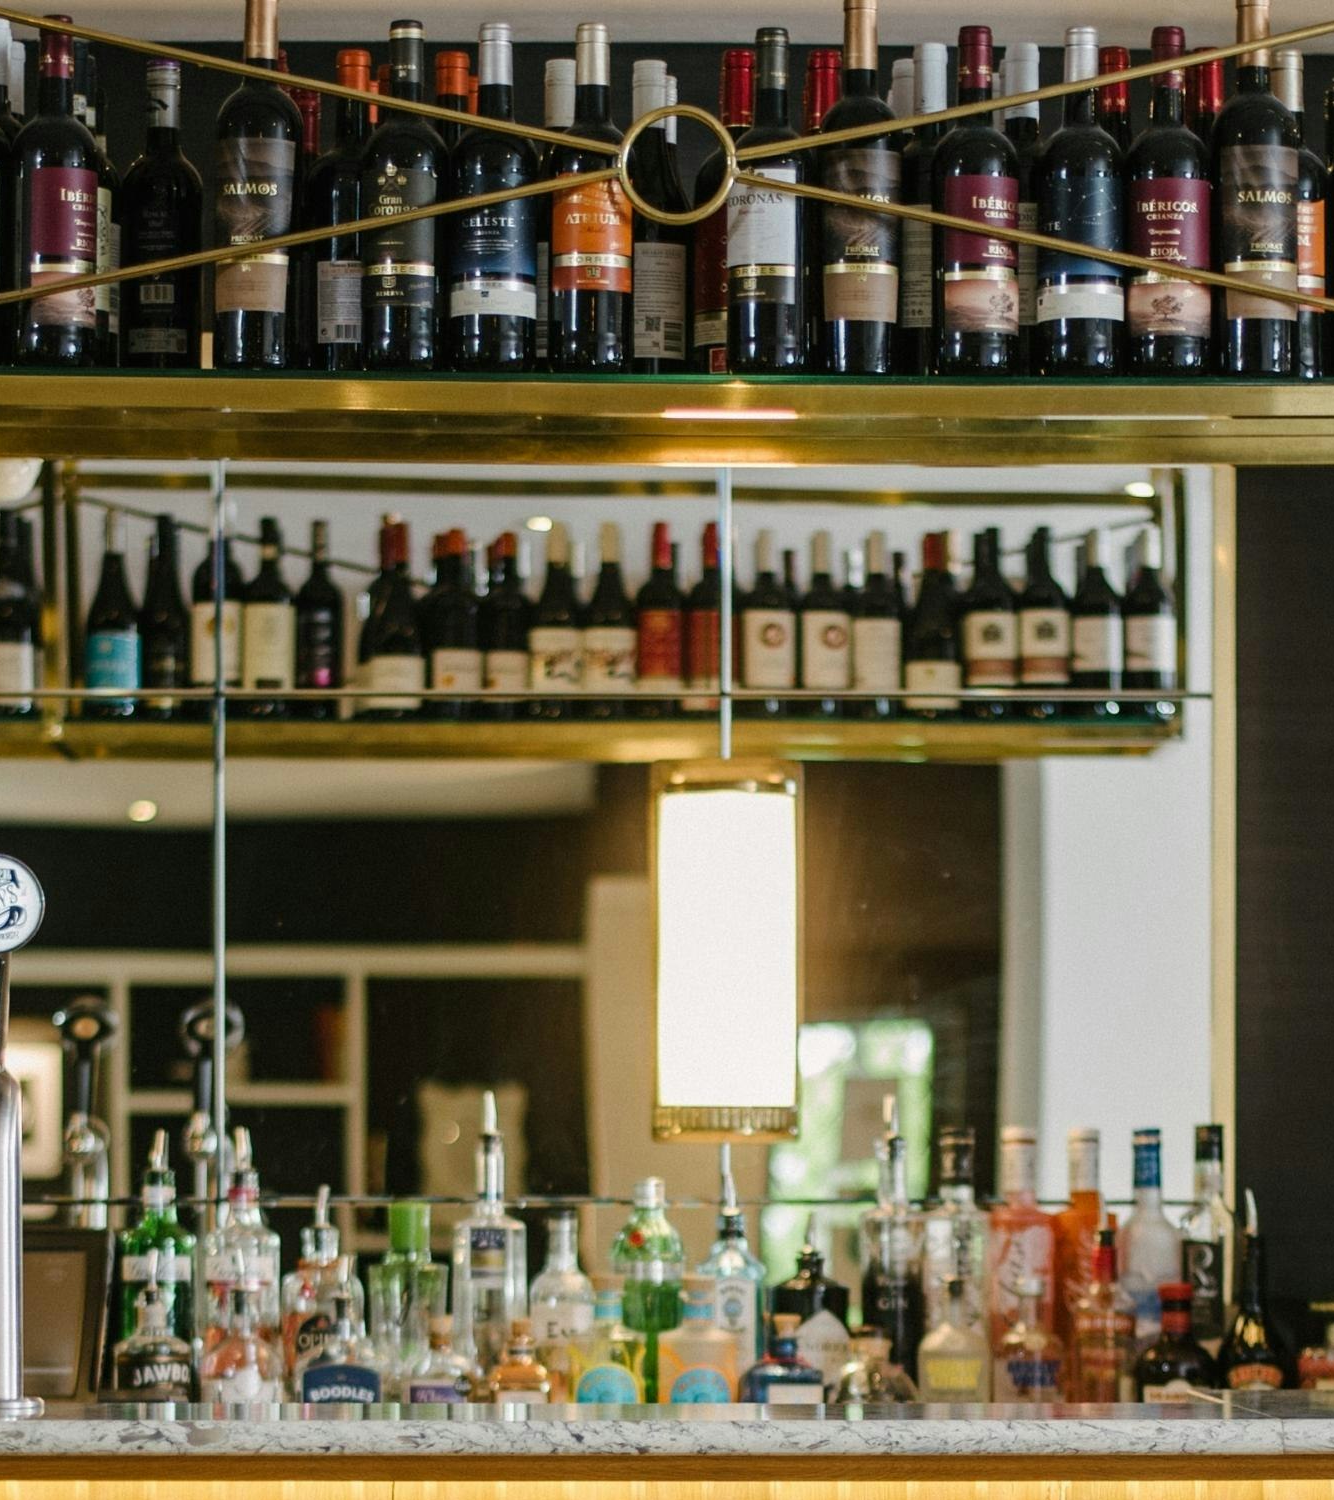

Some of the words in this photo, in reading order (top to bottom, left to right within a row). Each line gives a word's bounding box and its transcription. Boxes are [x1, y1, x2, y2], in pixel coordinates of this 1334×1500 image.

[223, 183, 278, 196] SALMOS
[379, 195, 402, 205] Gran
[1238, 189, 1292, 203] SALMOS
[1137, 200, 1199, 214] IBÉRICOS
[462, 216, 515, 228] CELESTE
[565, 212, 620, 226] ATRIUM
[1147, 213, 1185, 221] CRIANZA
[845, 245, 880, 254] PRIORAT
[1150, 248, 1179, 256] RIOJA
[568, 255, 620, 265] TORRES
[368, 266, 416, 275] TORRES
[310, 1386, 376, 1401] BOODLES
